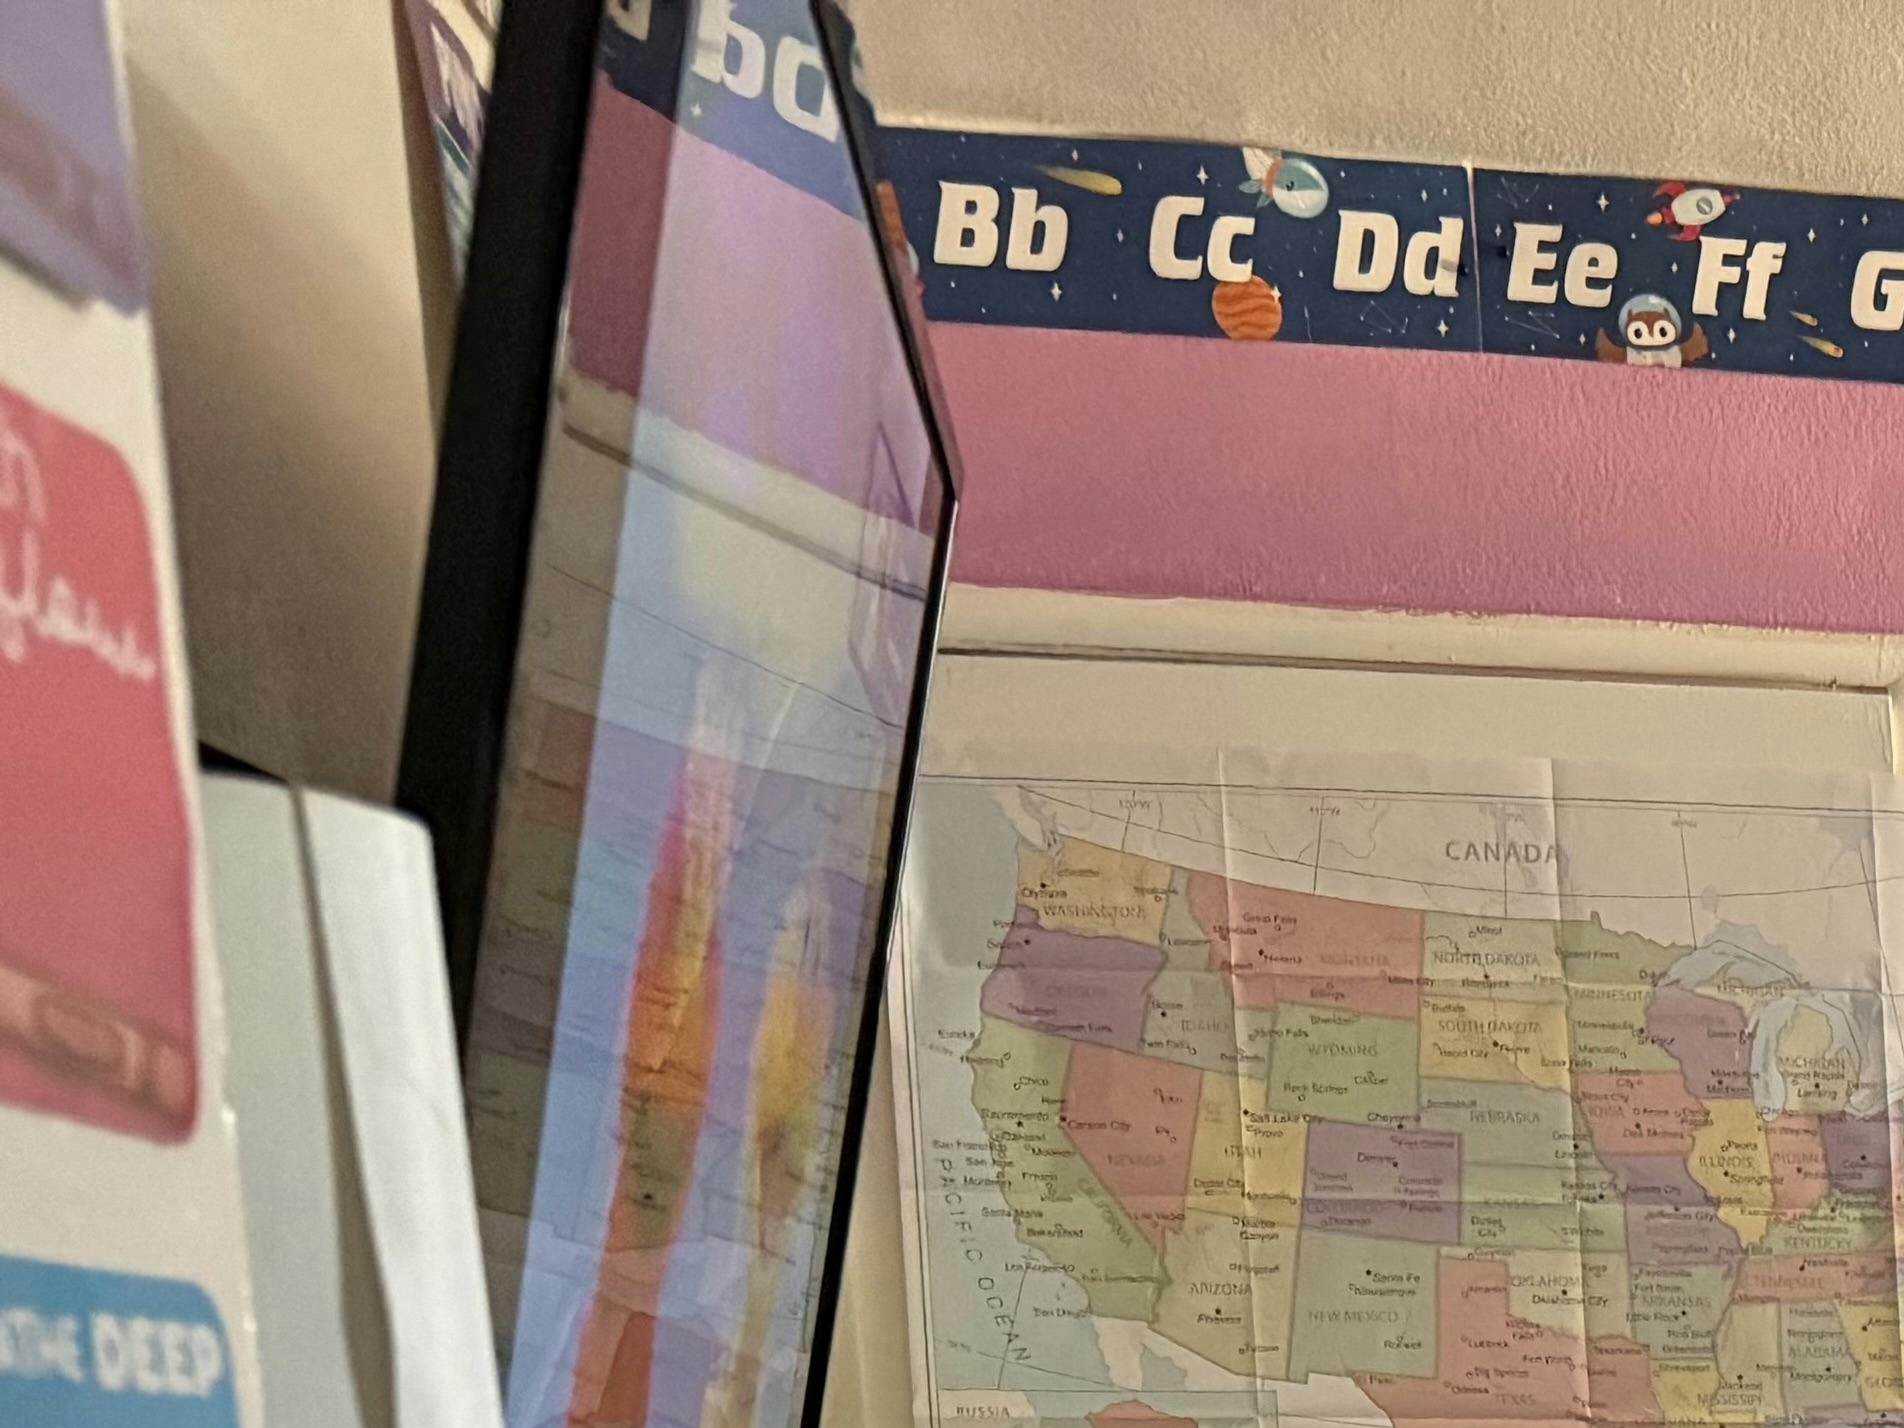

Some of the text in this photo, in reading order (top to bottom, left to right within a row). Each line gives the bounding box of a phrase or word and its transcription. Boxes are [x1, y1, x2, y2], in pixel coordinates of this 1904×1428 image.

[934, 181, 1069, 276] Bb
[1146, 196, 1253, 283] Cc
[1333, 210, 1462, 297] Dd
[1506, 225, 1613, 309] Ee
[1690, 235, 1786, 320] Ff
[1445, 841, 1560, 863] CANADA
